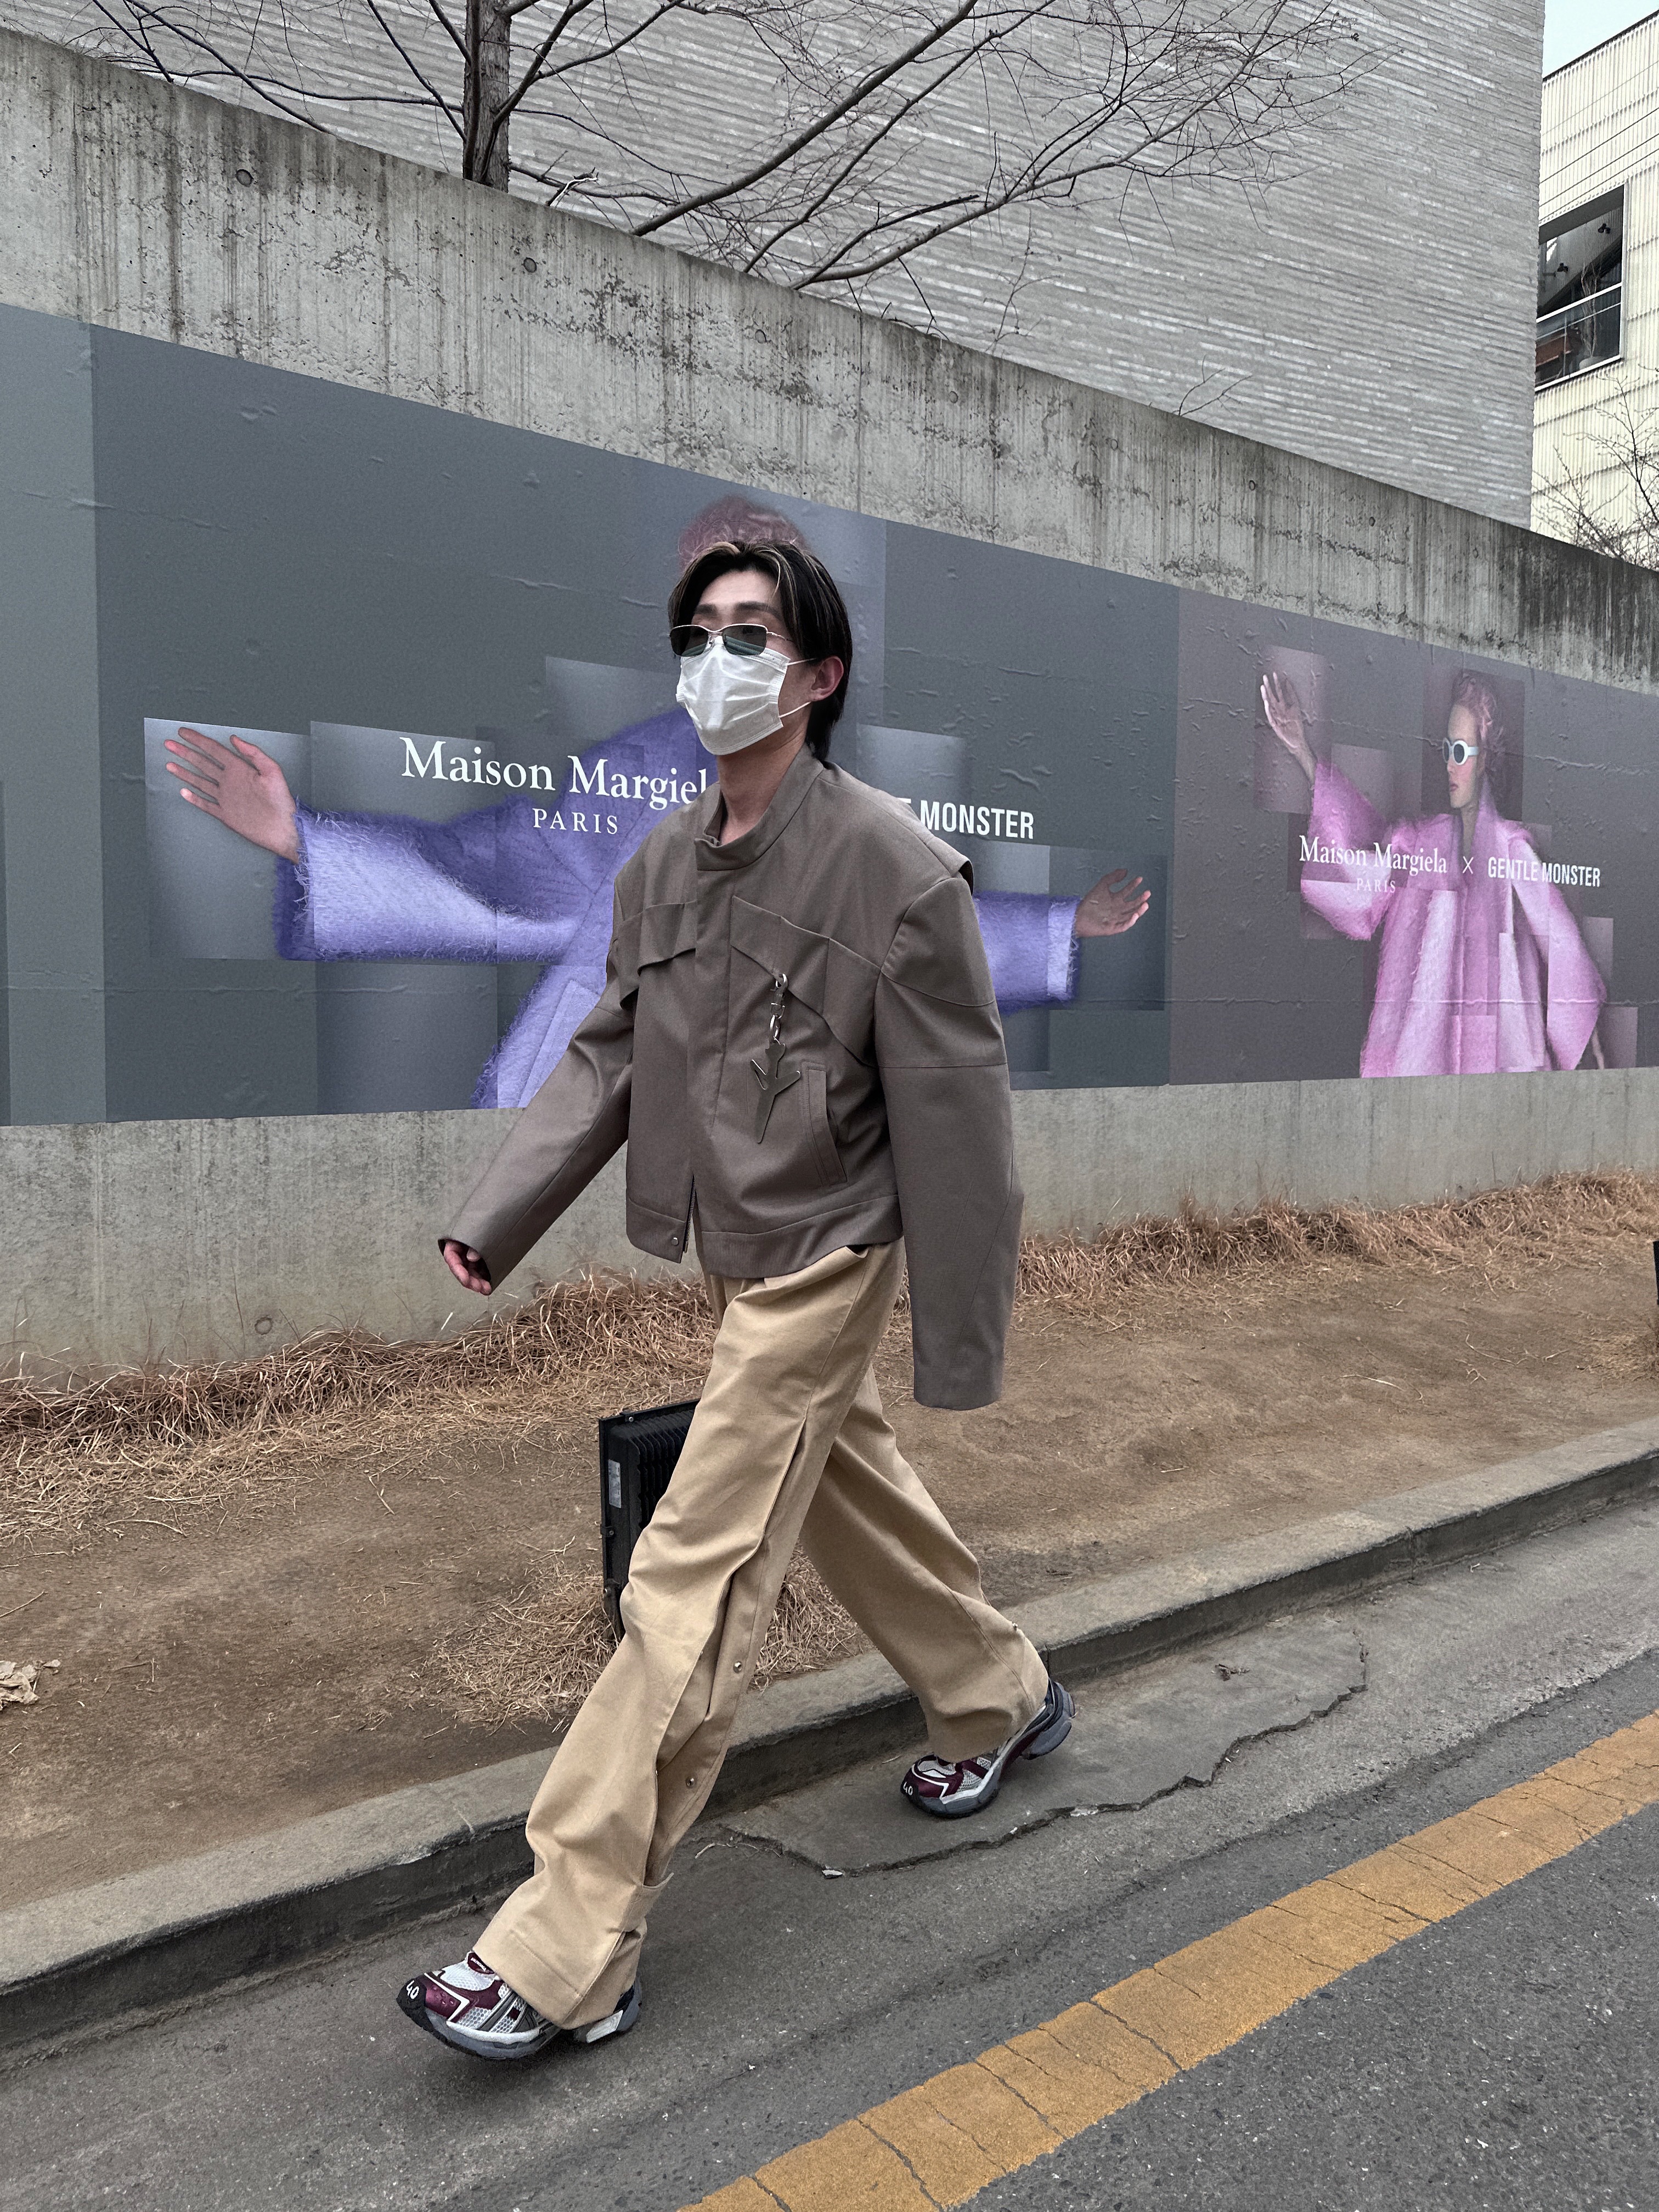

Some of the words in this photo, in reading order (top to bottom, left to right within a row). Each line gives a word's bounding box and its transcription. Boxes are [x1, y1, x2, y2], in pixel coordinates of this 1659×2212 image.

[399, 737, 556, 791] Maison
[567, 755, 707, 810] Margiel
[920, 799, 1034, 839] MONSTER
[532, 808, 618, 834] PARIS
[1299, 834, 1368, 866] Maison
[1373, 842, 1447, 876] Margiela
[1487, 856, 1538, 882] GENTLE
[1542, 862, 1601, 888] MONSTER
[1356, 878, 1396, 893] PARIS
[903, 1781, 913, 1796] 40
[406, 1980, 420, 1999] 40
